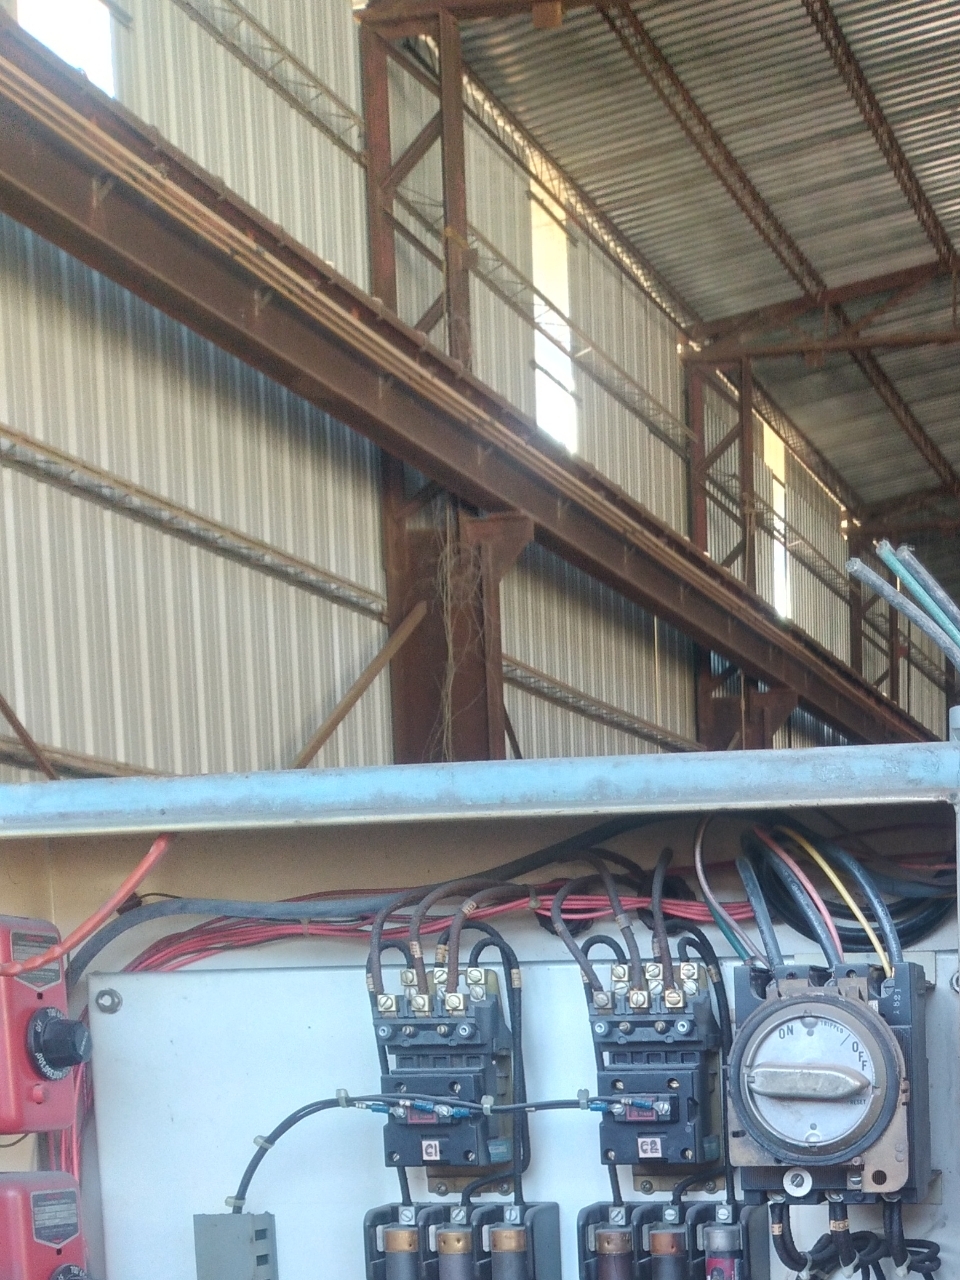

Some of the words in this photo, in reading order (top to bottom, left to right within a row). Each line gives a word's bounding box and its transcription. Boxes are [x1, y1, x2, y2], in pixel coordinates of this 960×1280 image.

[779, 1024, 795, 1040] ON
[820, 1020, 844, 1034] TRIPPED
[852, 1041, 868, 1072] OFF
[425, 1144, 438, 1157] C1
[640, 1140, 660, 1154] C2
